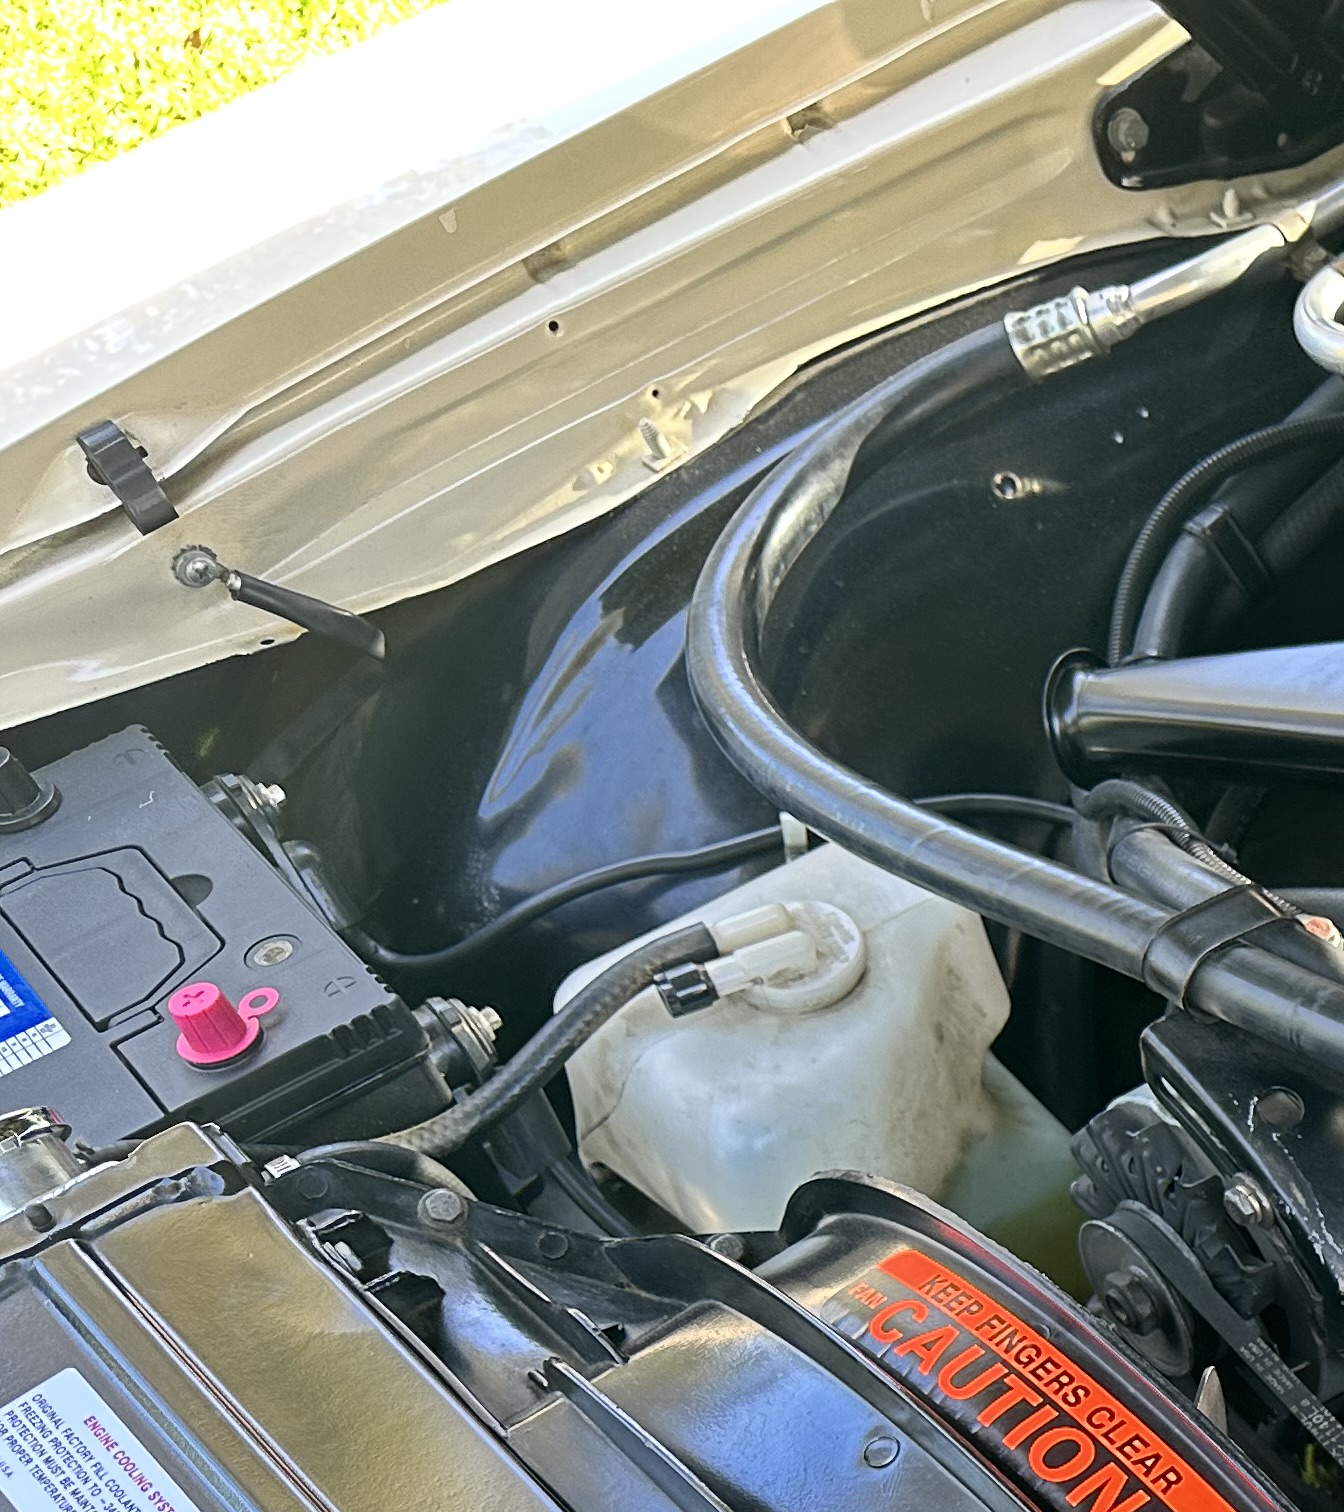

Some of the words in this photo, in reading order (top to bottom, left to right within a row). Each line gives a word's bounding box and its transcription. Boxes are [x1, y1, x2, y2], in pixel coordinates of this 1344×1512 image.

[847, 1281, 888, 1310] FAN
[918, 1273, 984, 1318] KEEP
[974, 1313, 1092, 1408] FINGERS
[1085, 1405, 1184, 1496] CLEAR
[1, 1409, 48, 1458] PROTECTION
[40, 1454, 66, 1479] MUST
[58, 1475, 75, 1490] BE
[1, 1434, 34, 1467] PROPER
[15, 1400, 54, 1439] FREEZING
[46, 1436, 93, 1485] PROTECTION
[85, 1482, 104, 1498] TO
[29, 1392, 66, 1430] ORIGINAL
[59, 1426, 96, 1464] FACTORY
[88, 1460, 110, 1481] FILL
[82, 1414, 119, 1452] ENGINE
[111, 1448, 154, 1493] COOLING
